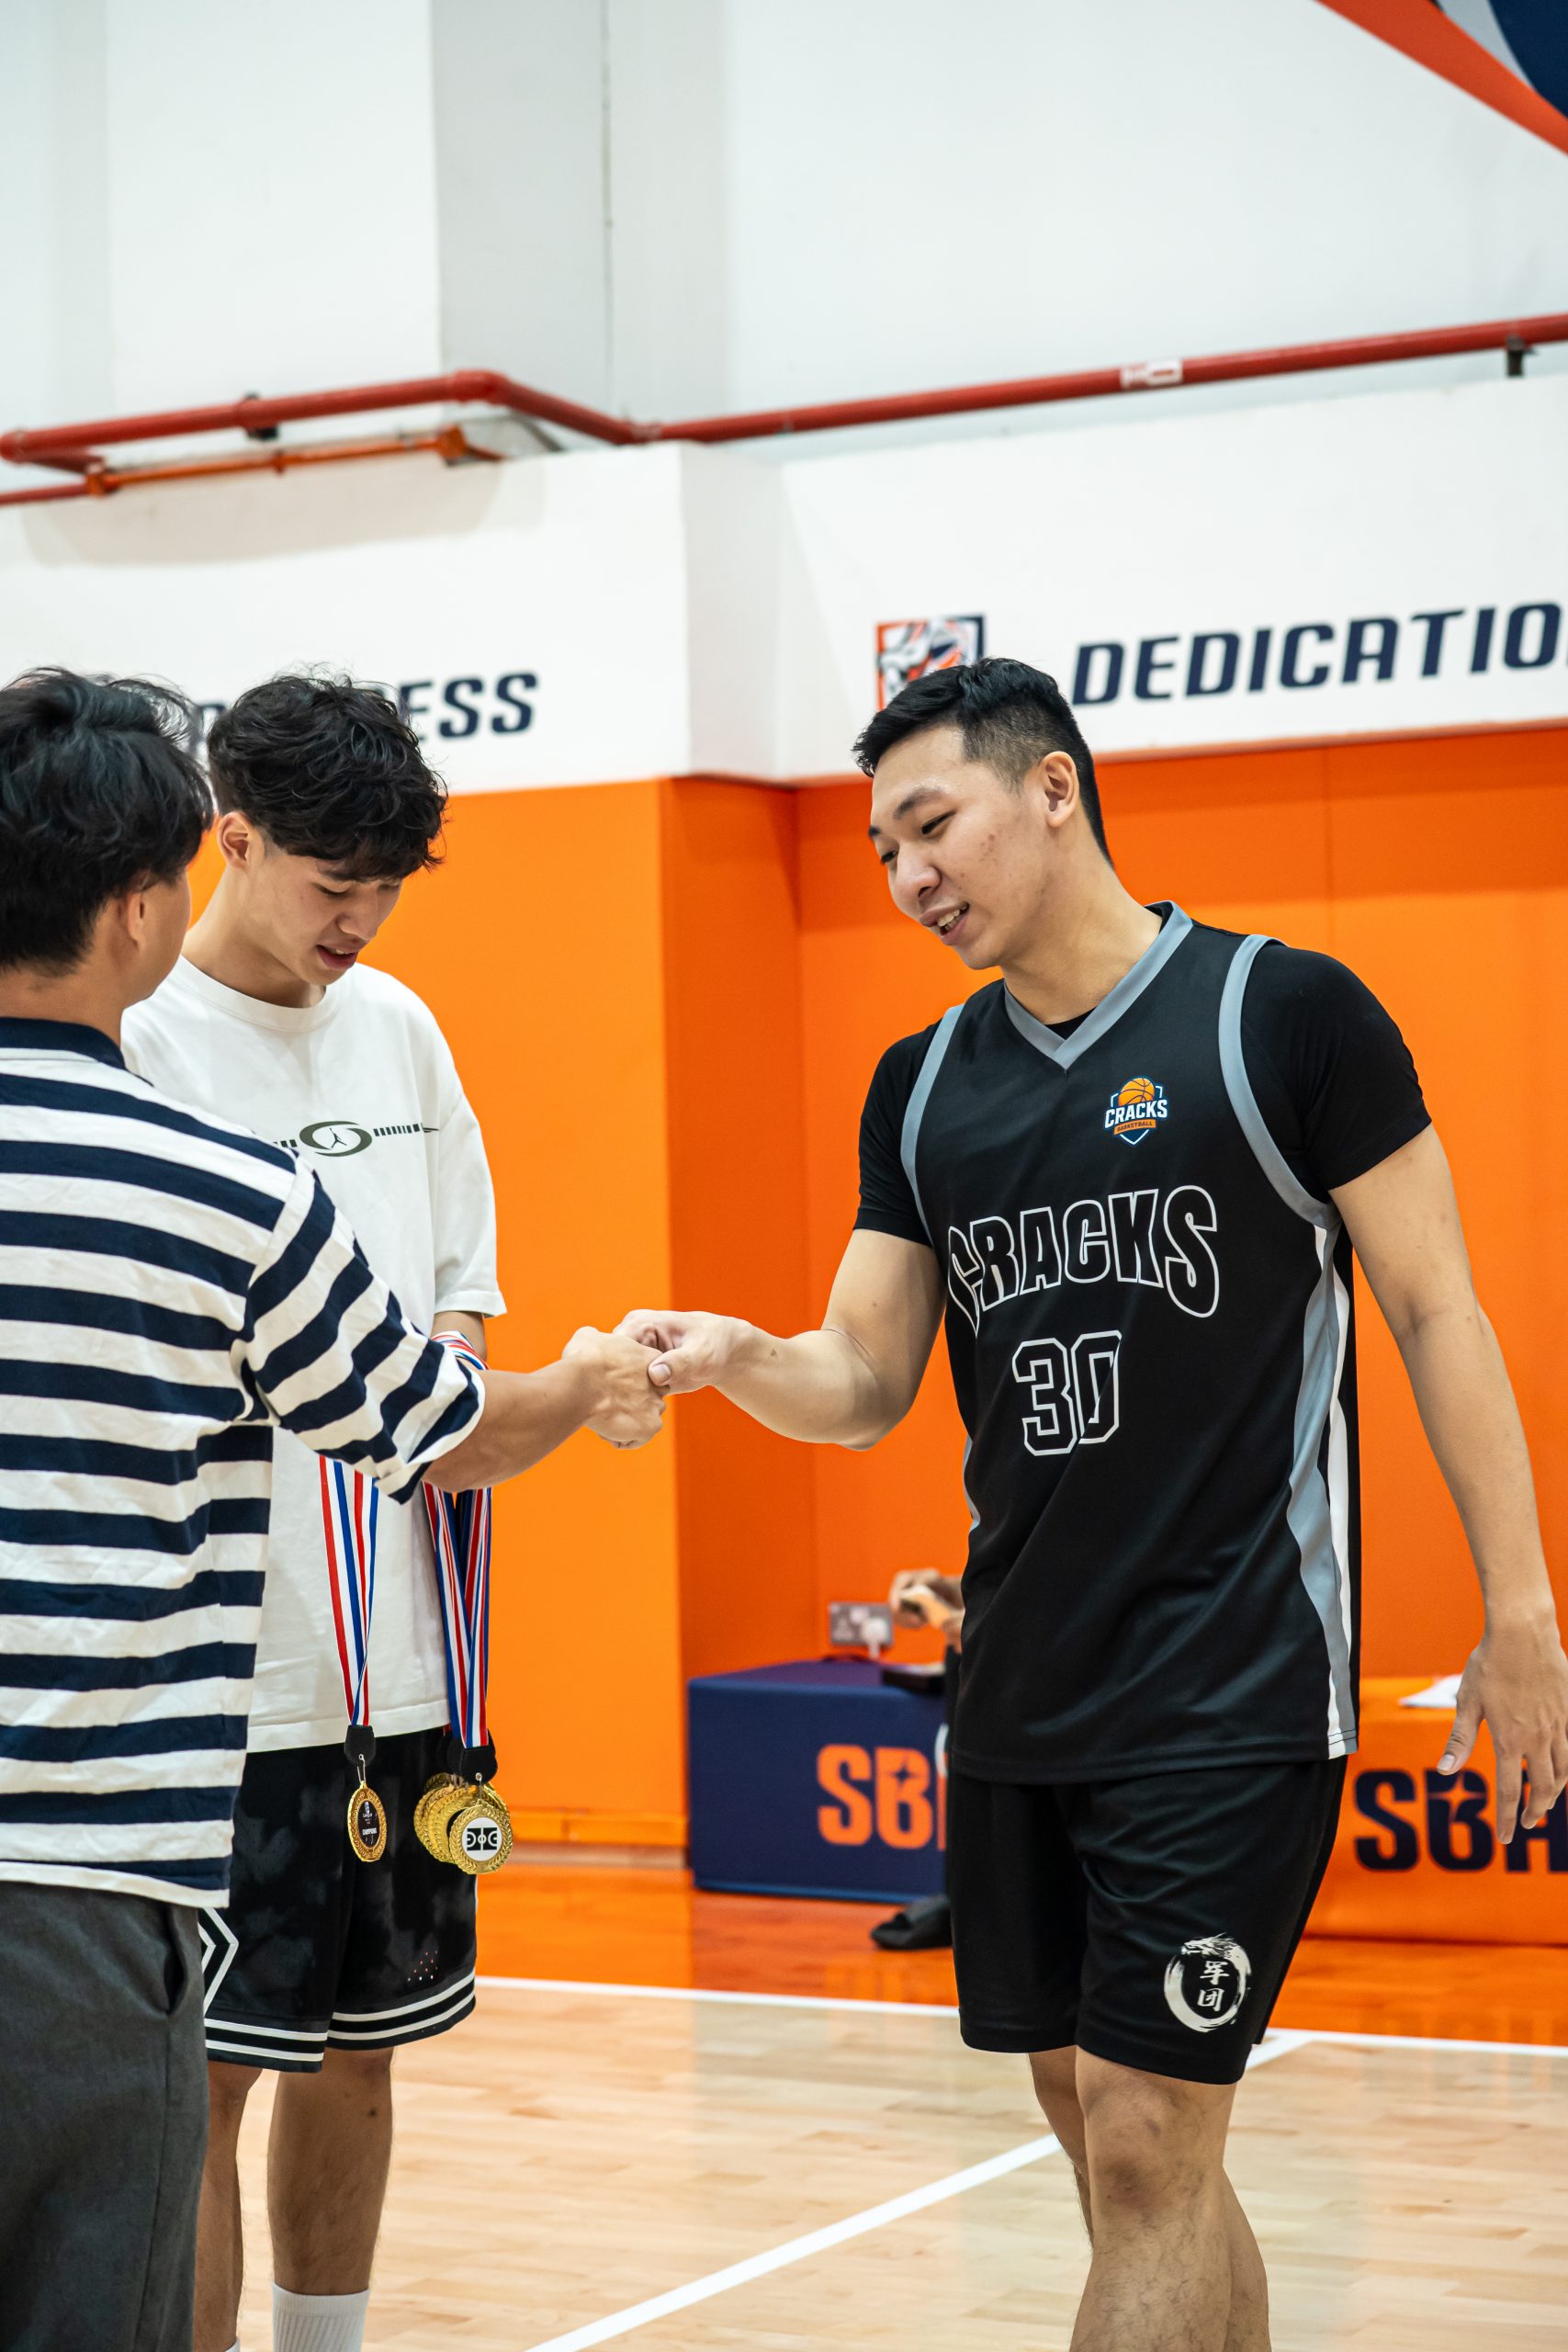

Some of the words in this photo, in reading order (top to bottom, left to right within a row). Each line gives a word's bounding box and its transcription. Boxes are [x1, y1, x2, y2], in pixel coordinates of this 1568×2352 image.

[1072, 602, 1568, 707] DEDICATIO
[1104, 1099, 1168, 1128] CRACKS
[1117, 1121, 1153, 1132] BASKETBALL
[948, 1184, 1220, 1338] CRACKS
[1012, 1329, 1122, 1456] 30
